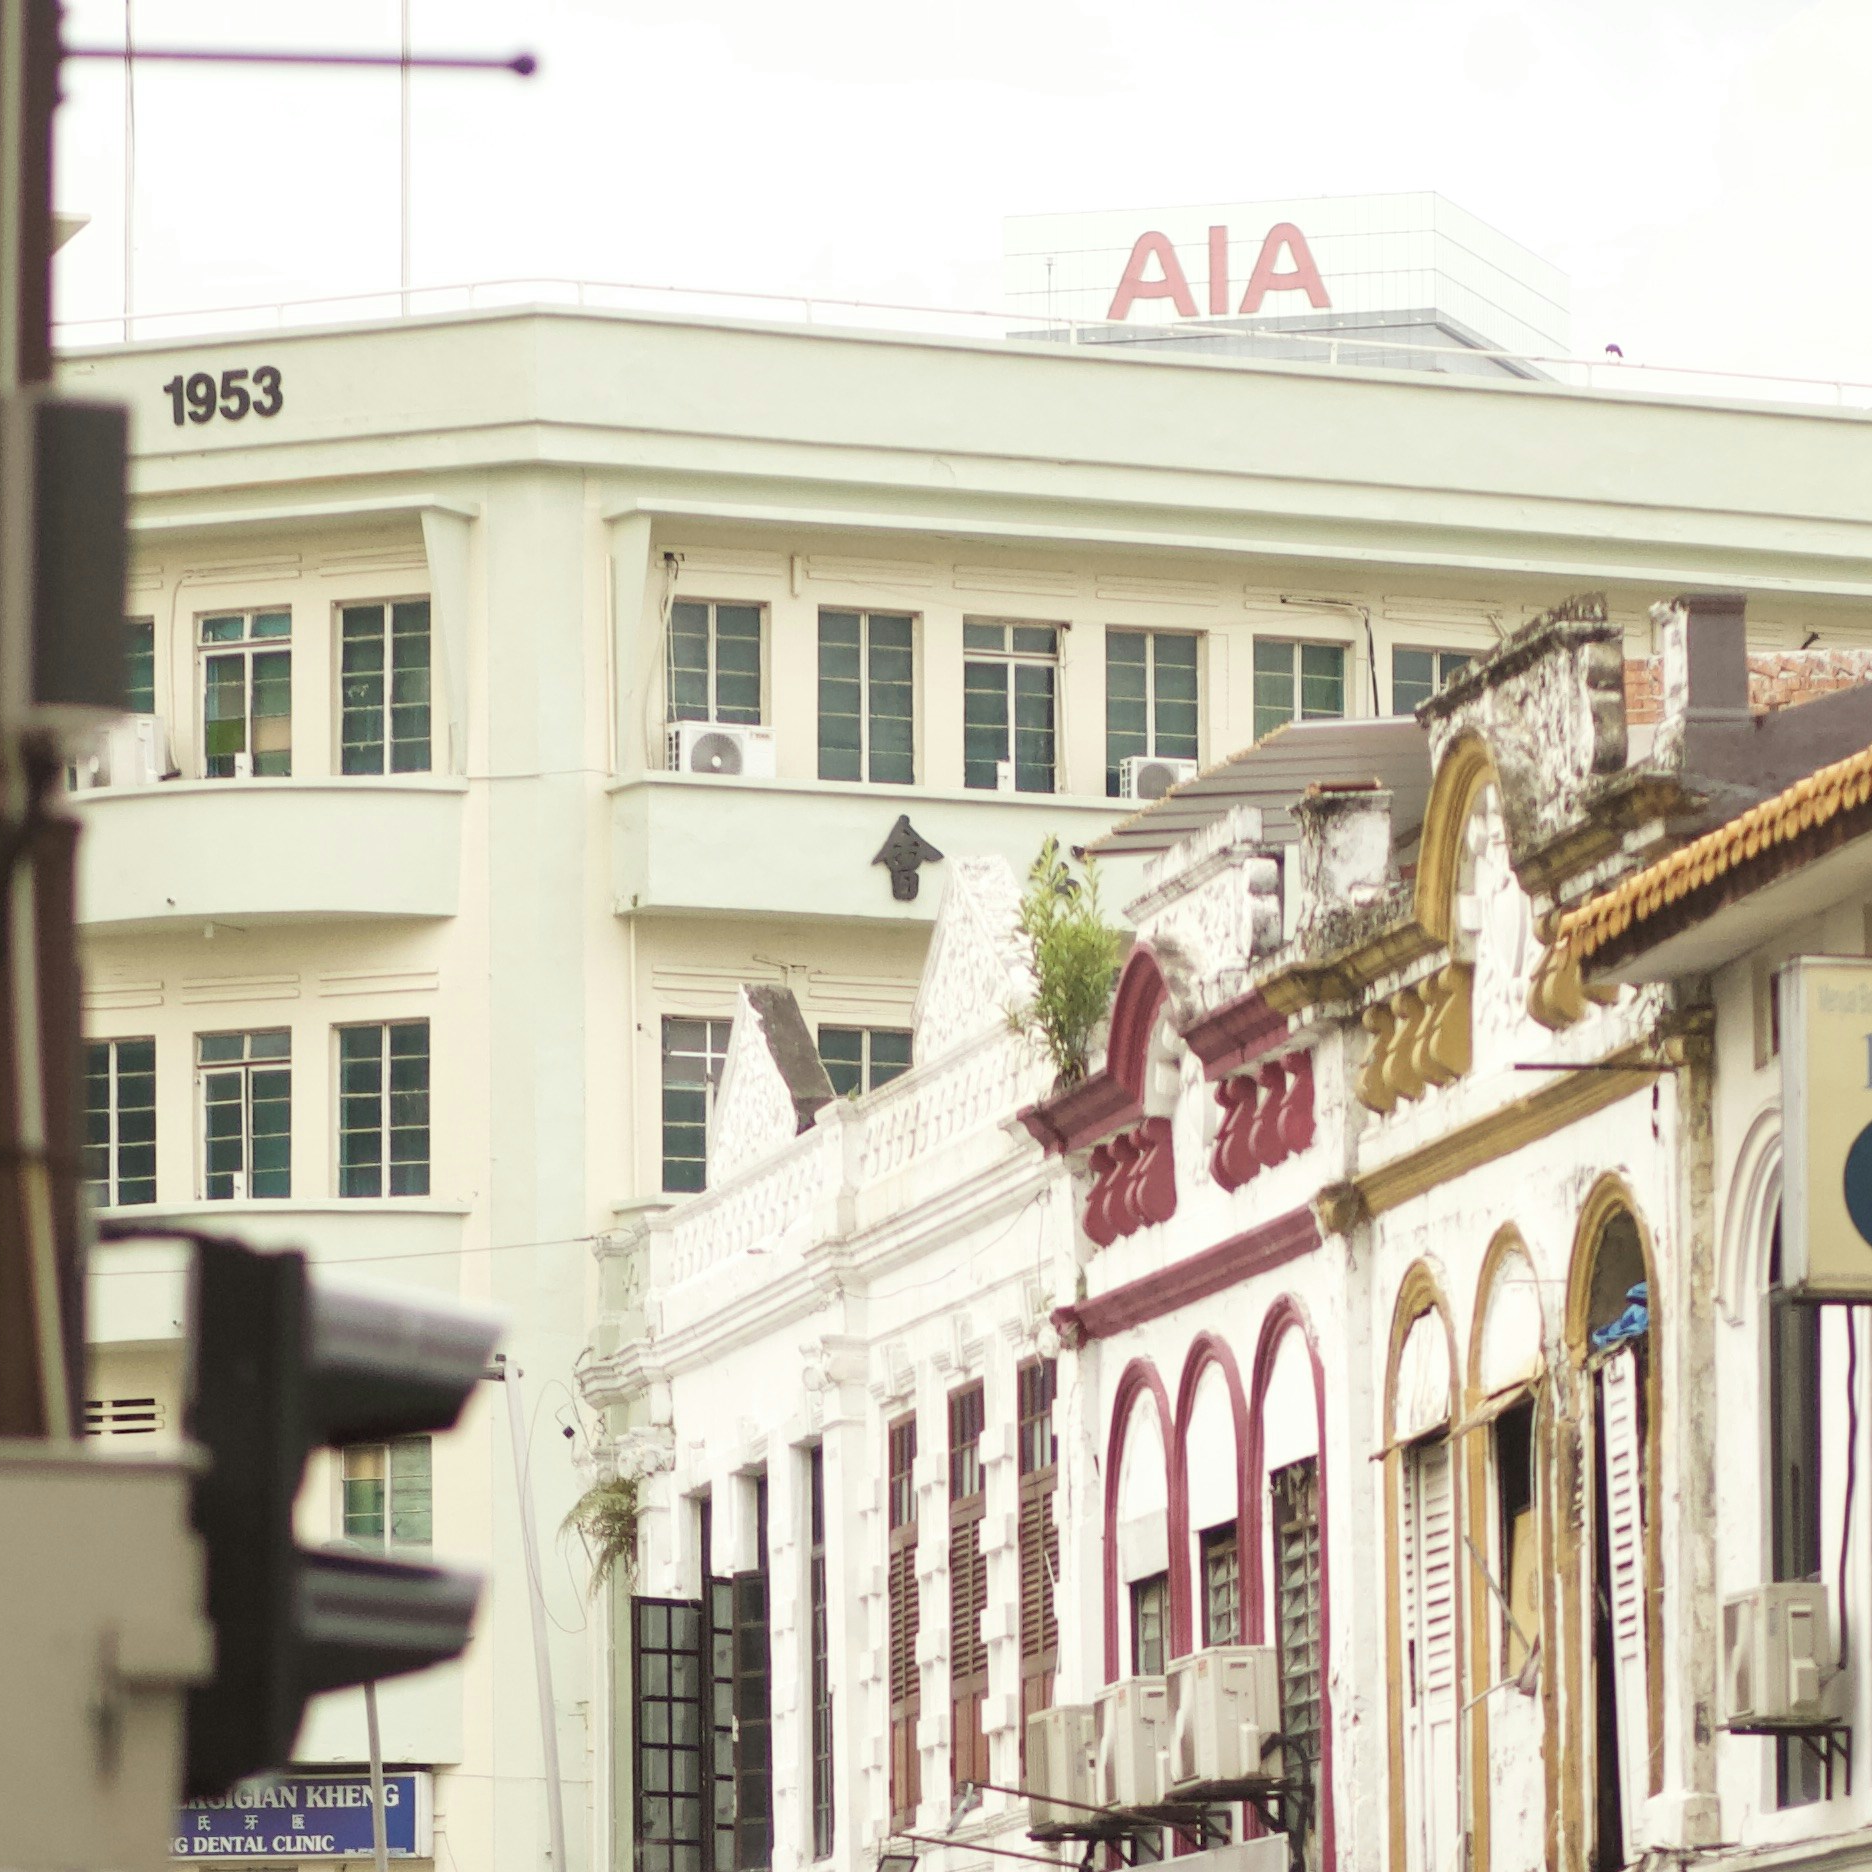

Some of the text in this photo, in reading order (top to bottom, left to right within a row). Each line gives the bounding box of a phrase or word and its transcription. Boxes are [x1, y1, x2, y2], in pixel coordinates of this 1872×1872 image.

[1107, 221, 1331, 320] AIA
[162, 365, 284, 428] 1953
[194, 1835, 266, 1853] DENTAL
[272, 1835, 335, 1852] CLINIC
